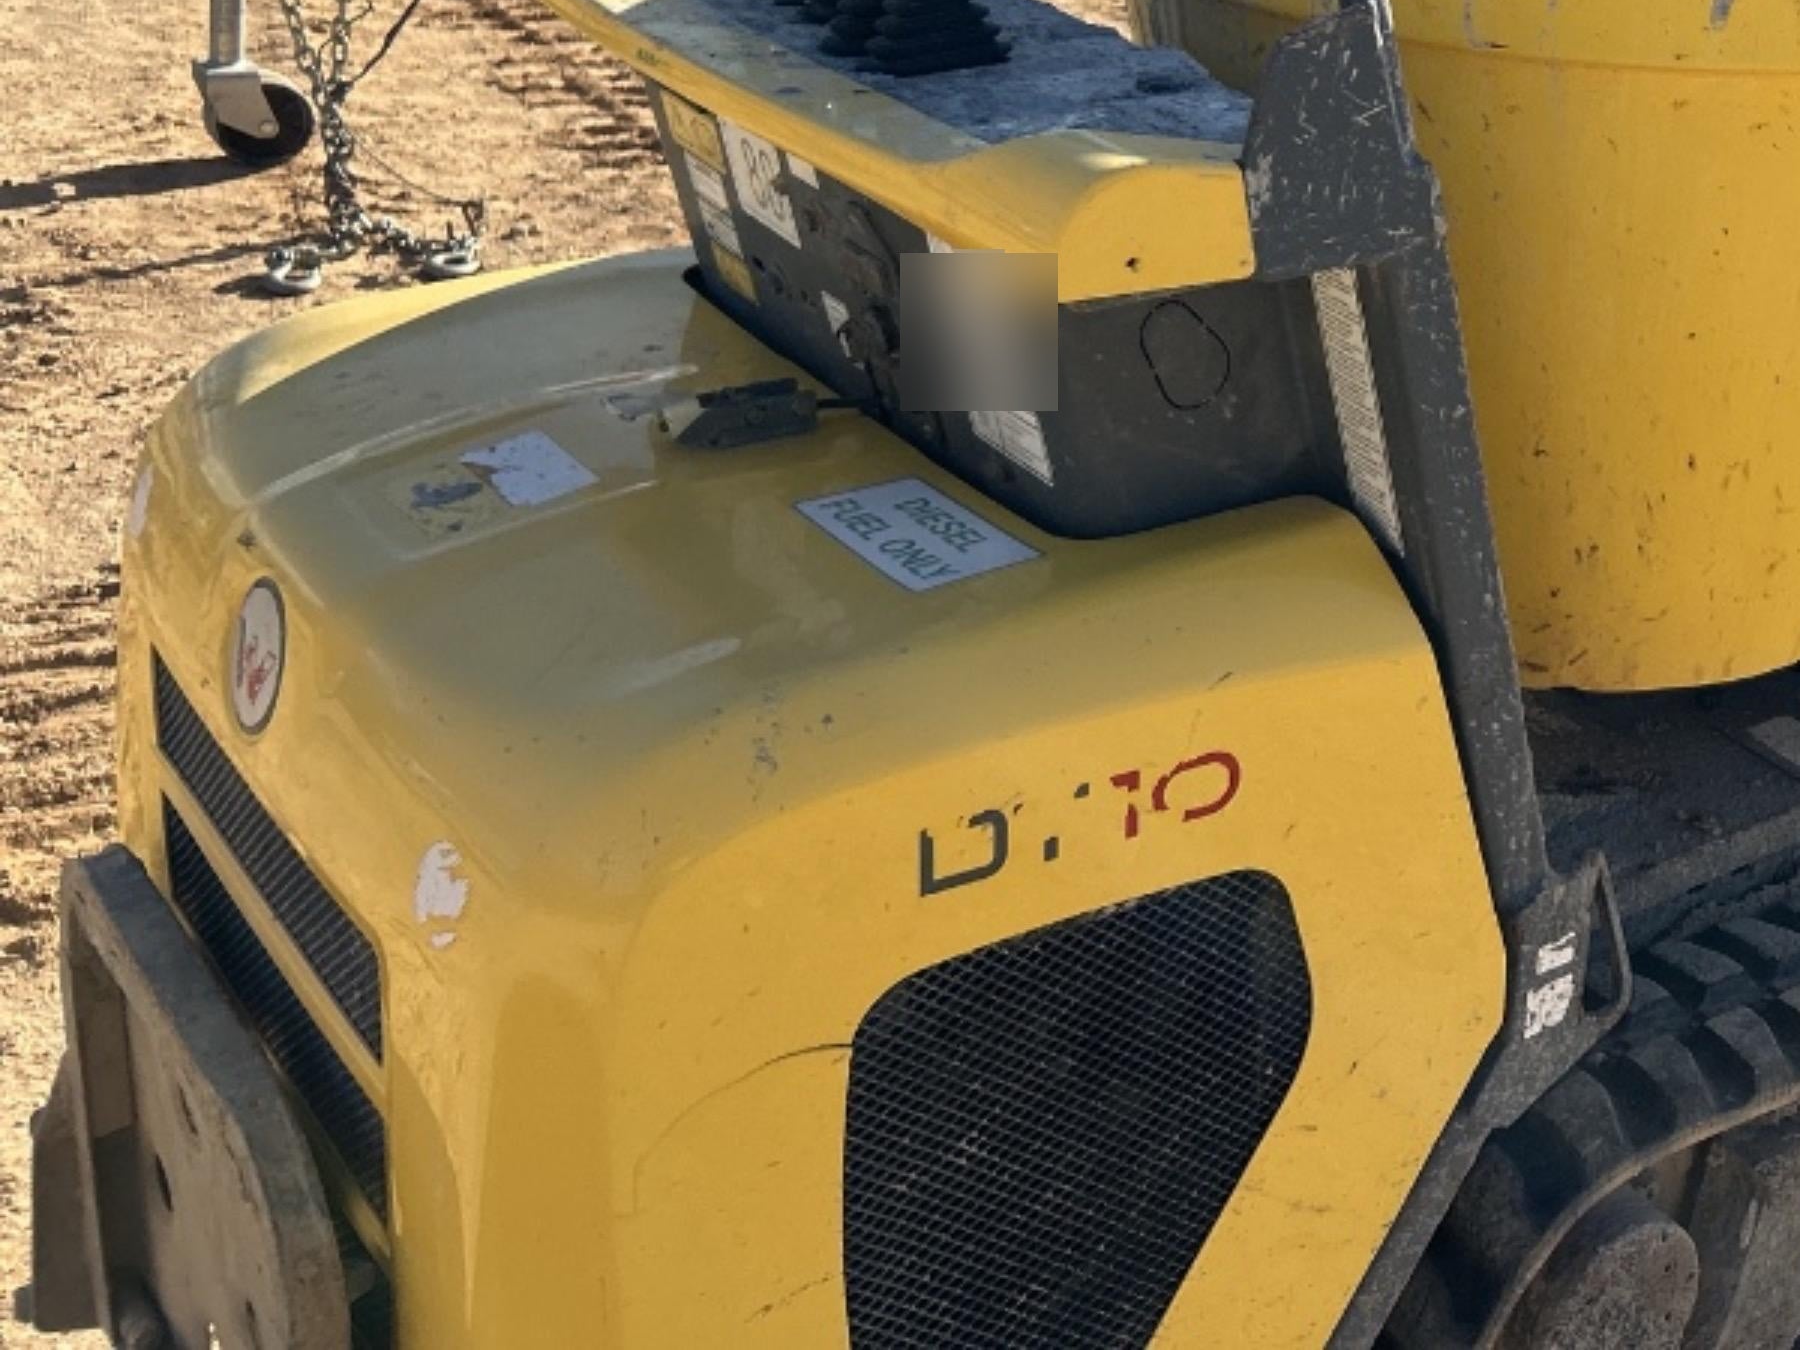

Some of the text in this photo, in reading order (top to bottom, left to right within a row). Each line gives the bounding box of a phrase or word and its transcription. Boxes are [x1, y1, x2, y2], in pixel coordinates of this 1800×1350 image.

[819, 498, 961, 580] FUEL ONLY
[895, 497, 988, 554] DIESEL
